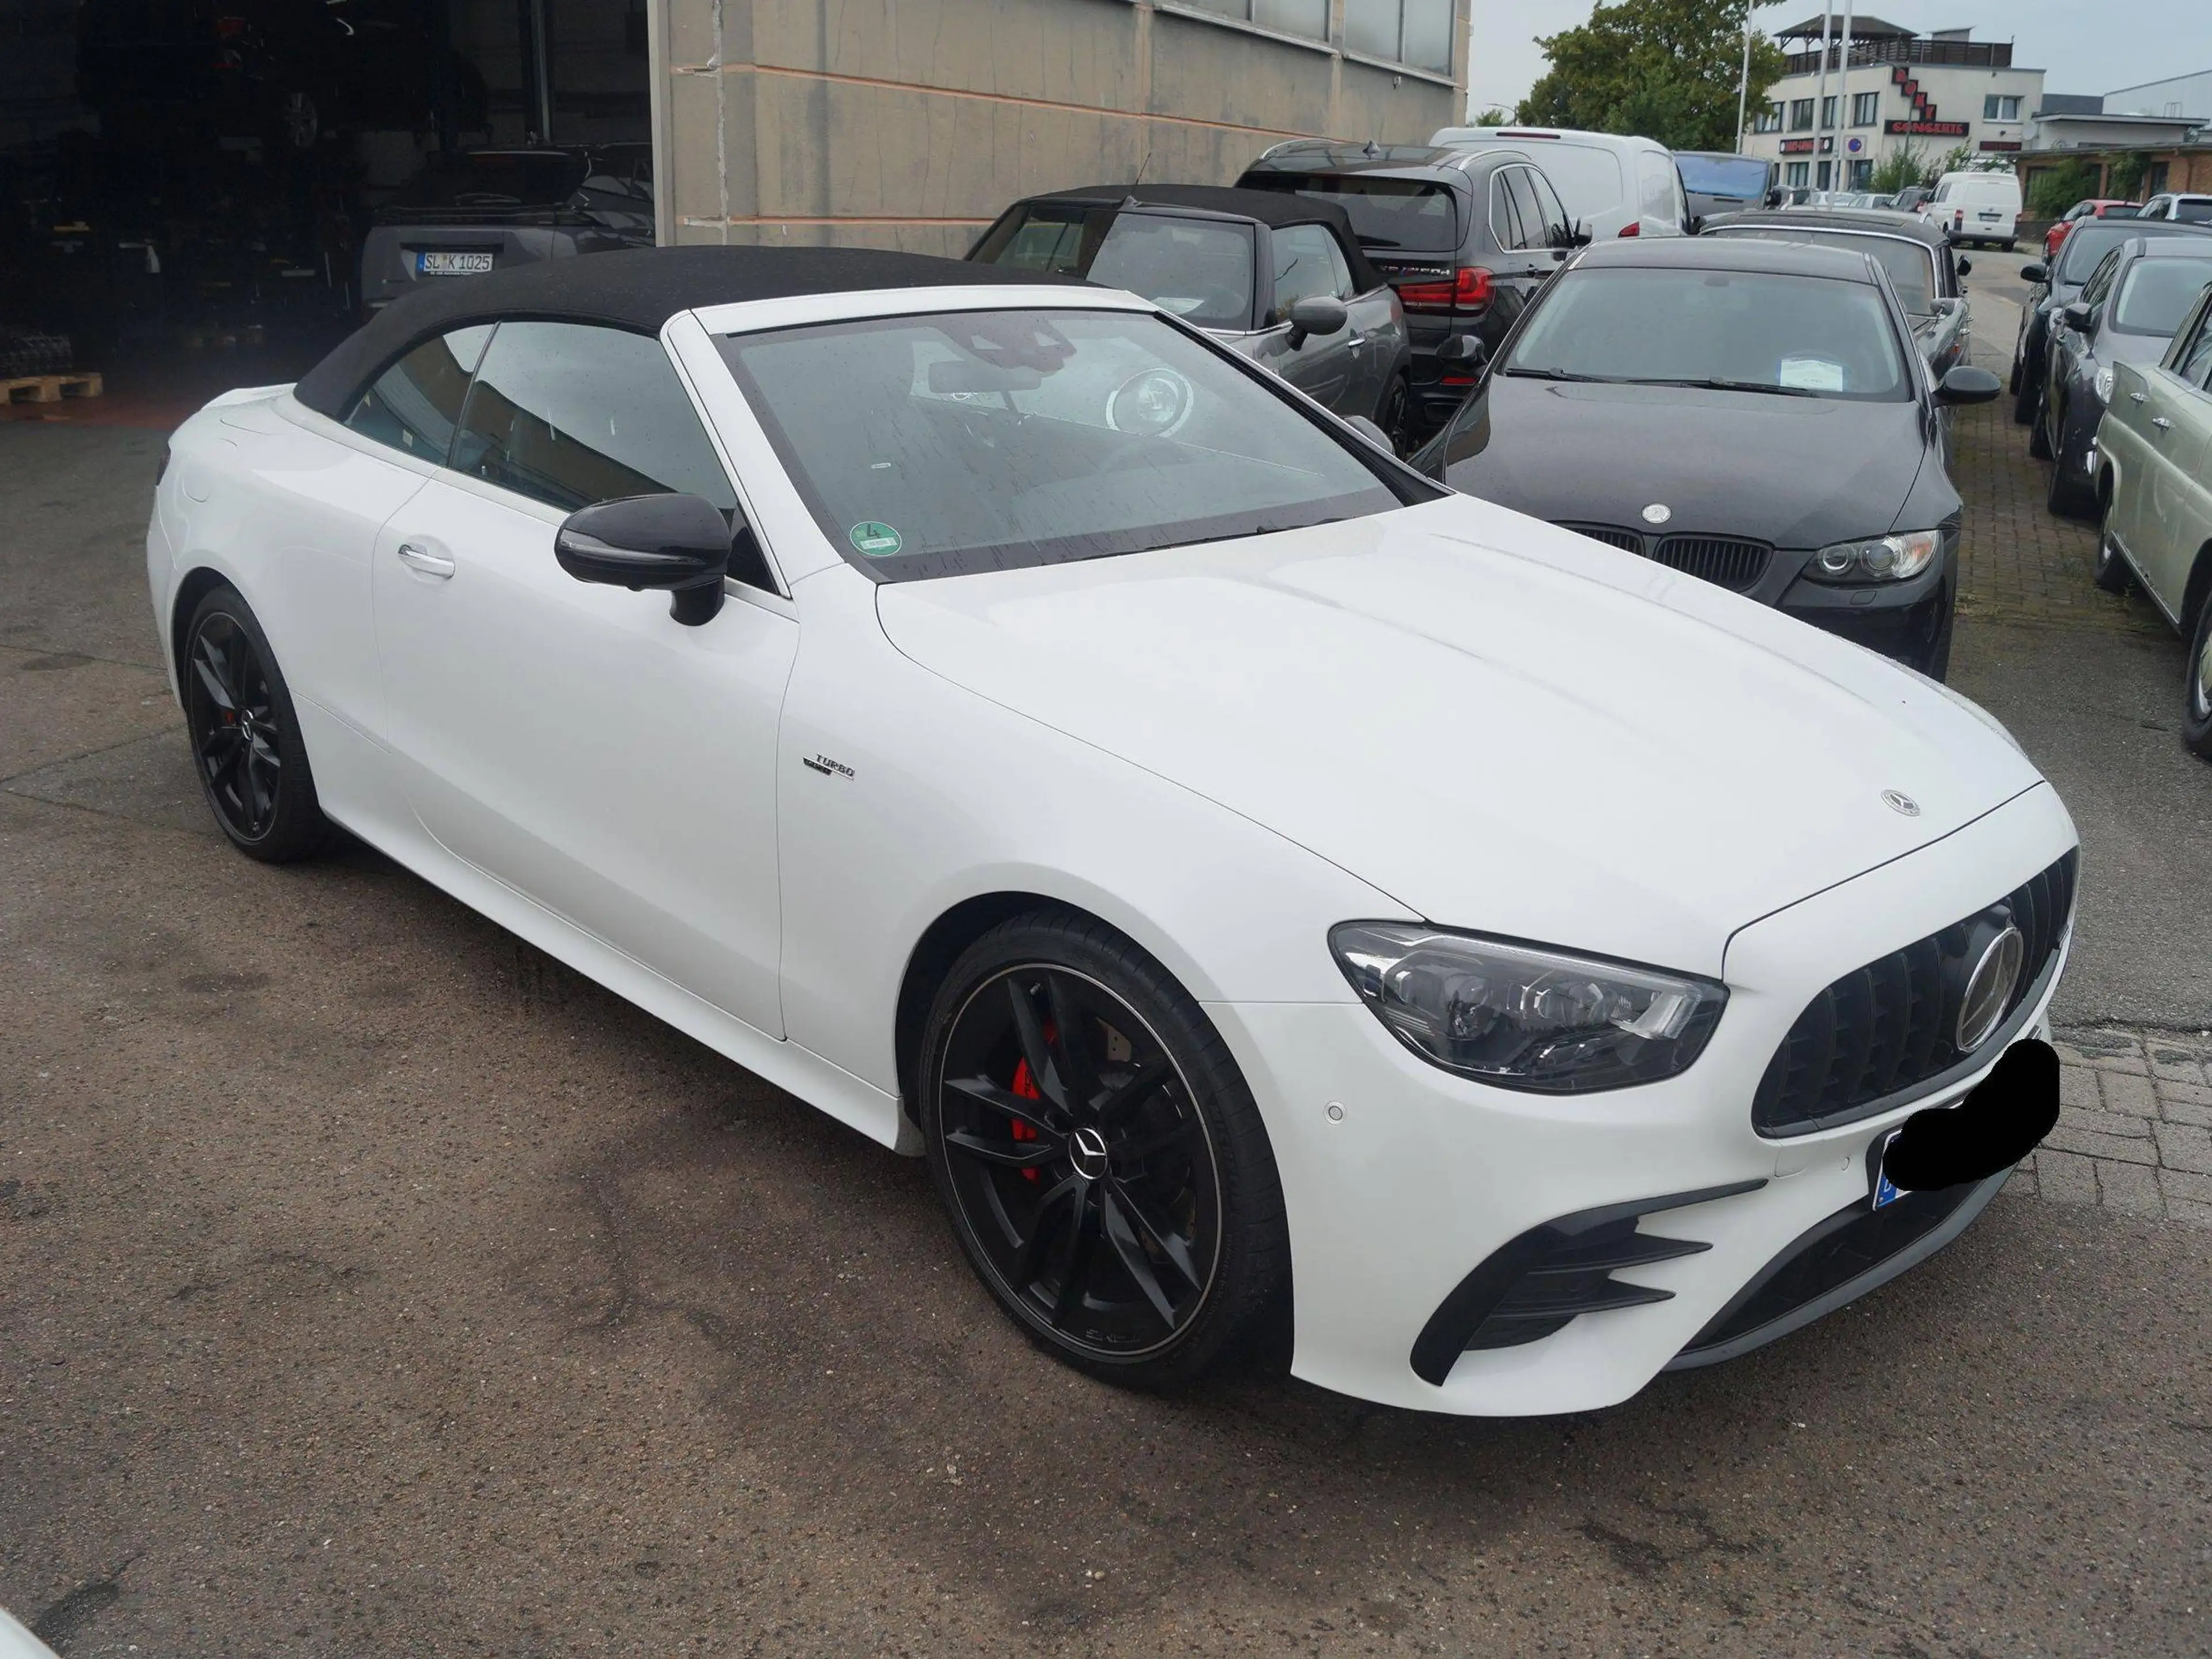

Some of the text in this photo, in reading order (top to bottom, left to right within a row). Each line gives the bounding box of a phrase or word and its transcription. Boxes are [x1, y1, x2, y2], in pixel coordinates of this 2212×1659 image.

[425, 254, 490, 270] SL K 1025
[816, 753, 856, 777] TURBO
